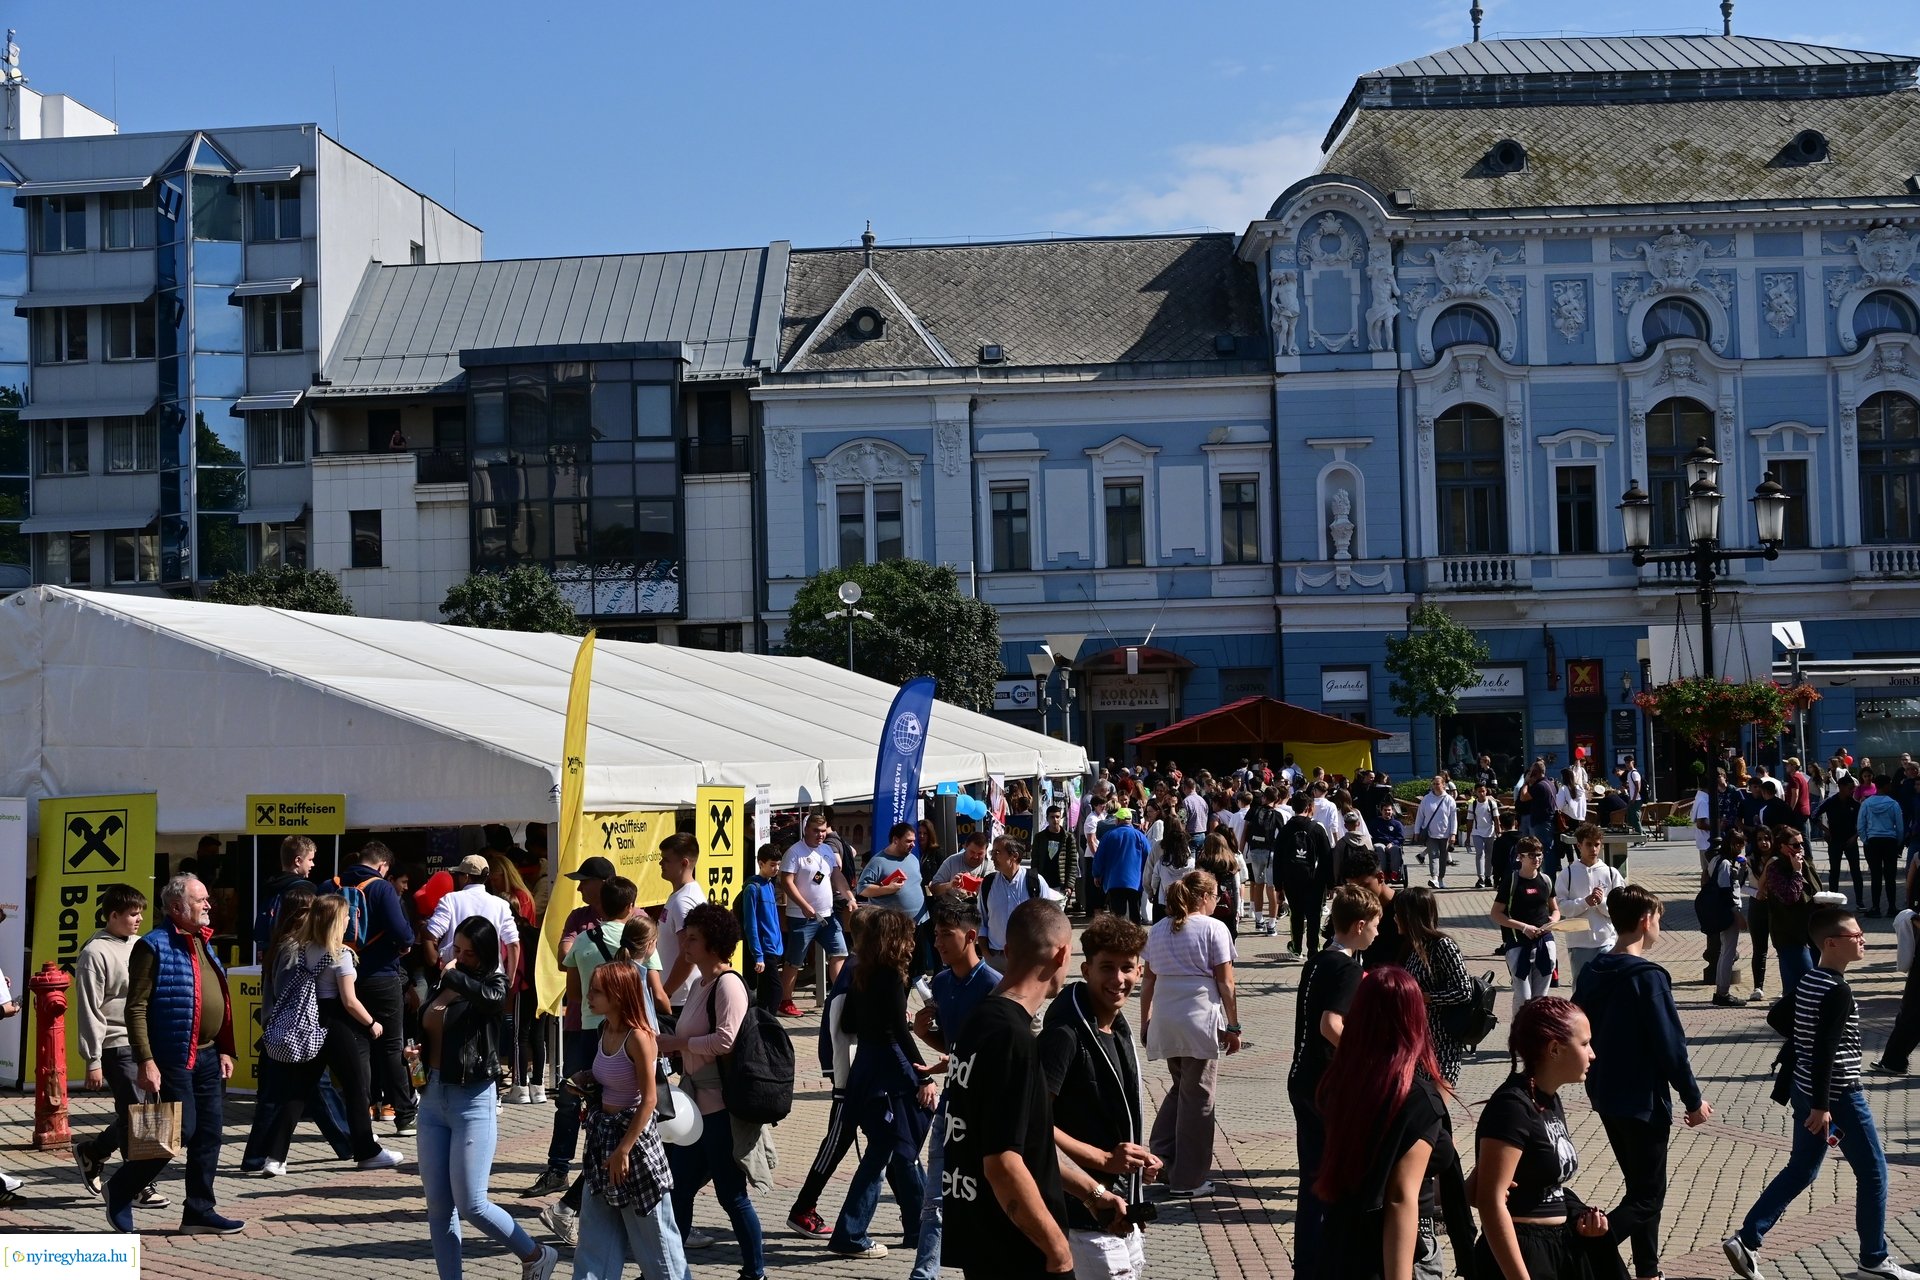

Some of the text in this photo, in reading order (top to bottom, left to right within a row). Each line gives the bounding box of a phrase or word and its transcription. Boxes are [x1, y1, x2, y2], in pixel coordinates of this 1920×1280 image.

[1225, 682, 1265, 692] CASINO
[1325, 679, 1364, 693] Gardrobe
[279, 803, 336, 814] Raiffeisen
[279, 815, 309, 826] Bank
[616, 836, 635, 850] Bank
[57, 885, 89, 978] Bank
